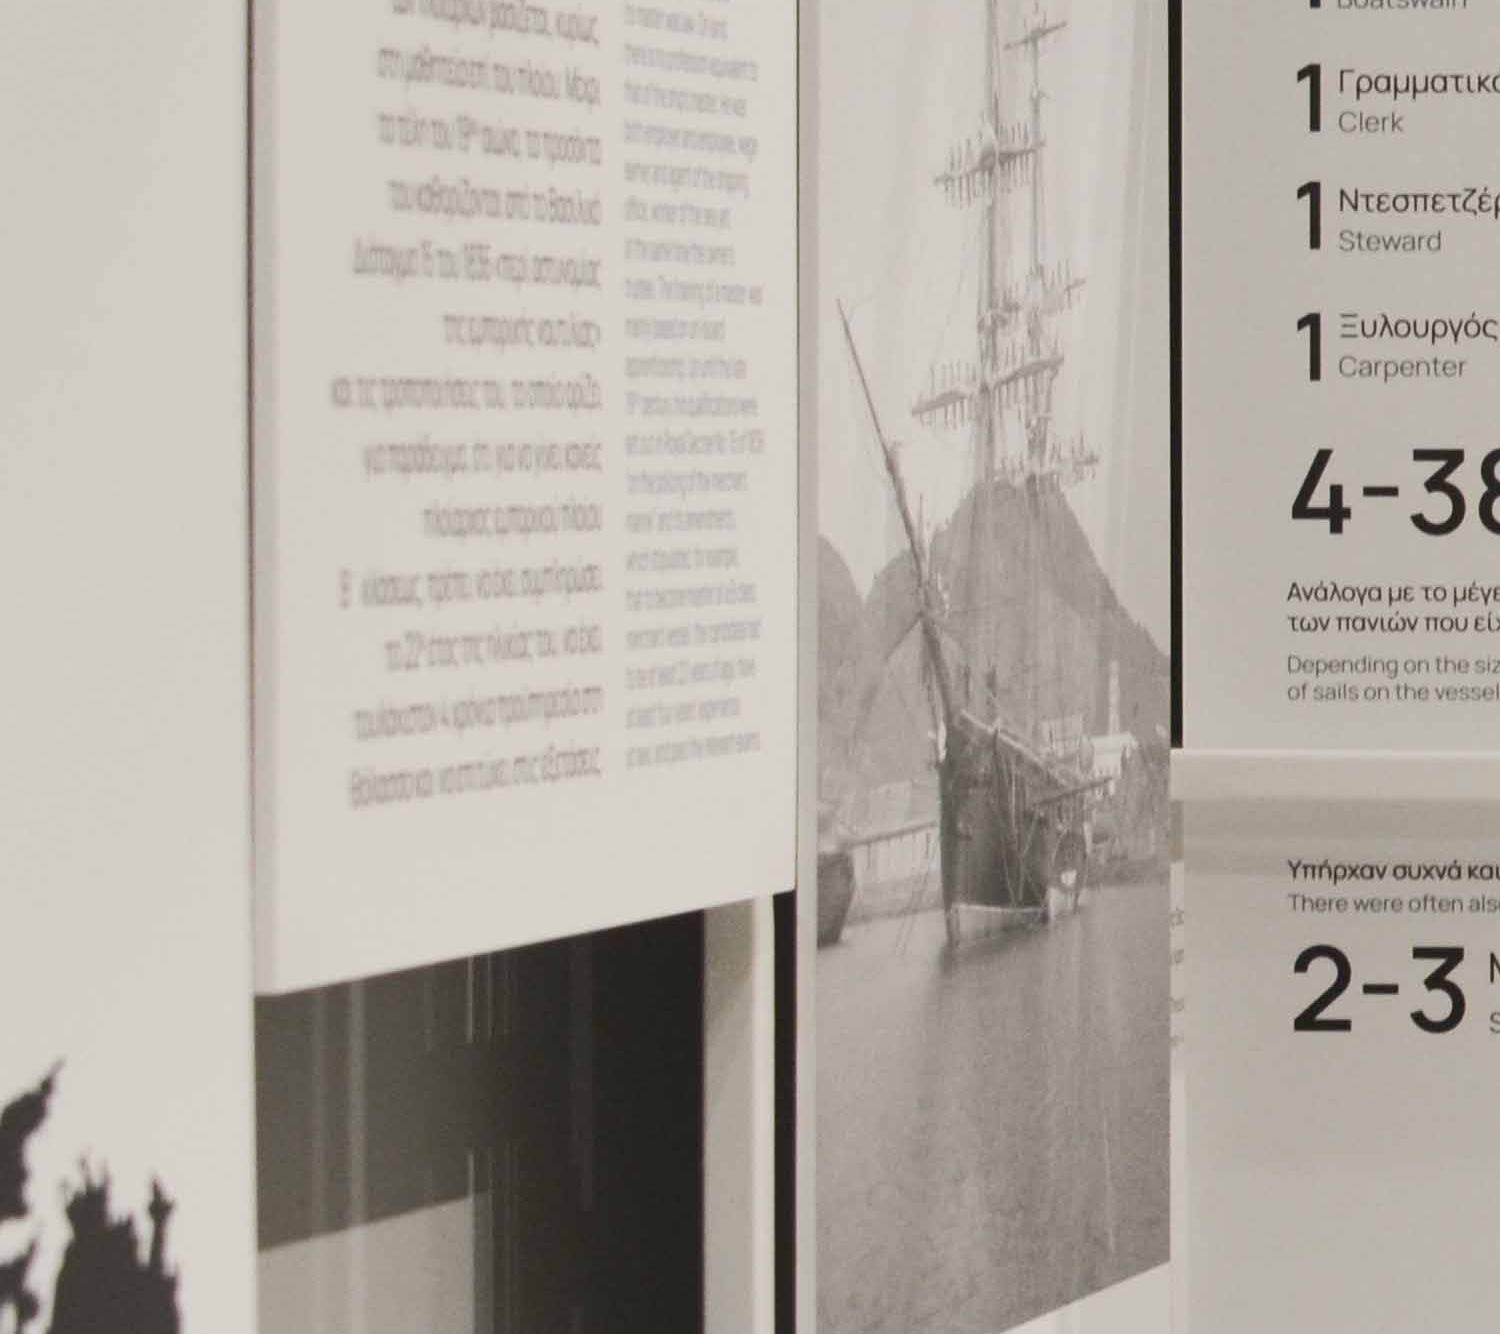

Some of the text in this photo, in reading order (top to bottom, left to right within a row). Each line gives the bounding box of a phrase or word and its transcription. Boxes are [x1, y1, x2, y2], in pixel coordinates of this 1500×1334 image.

[1297, 63, 1321, 132] 1
[1338, 111, 1403, 133] Clerk
[1297, 181, 1321, 250] 1
[1339, 230, 1441, 252] Steward
[1340, 312, 1498, 345] Ξυλουργός
[1297, 312, 1321, 381] 1
[1338, 355, 1466, 383] Carpenter
[1287, 581, 1382, 606] Ανάλογα
[1388, 586, 1414, 607] με
[1421, 586, 1447, 602] το
[1288, 616, 1330, 632] των
[1336, 611, 1418, 632] πανιών
[1424, 616, 1468, 632] που
[1287, 654, 1398, 680] Depending
[1403, 659, 1429, 674] on
[1435, 656, 1470, 674] the
[1288, 859, 1387, 885] Υπήρχαν
[1392, 859, 1462, 880] συχνά
[1288, 893, 1348, 913] There
[1353, 898, 1403, 913] were
[1408, 894, 1463, 913] often
